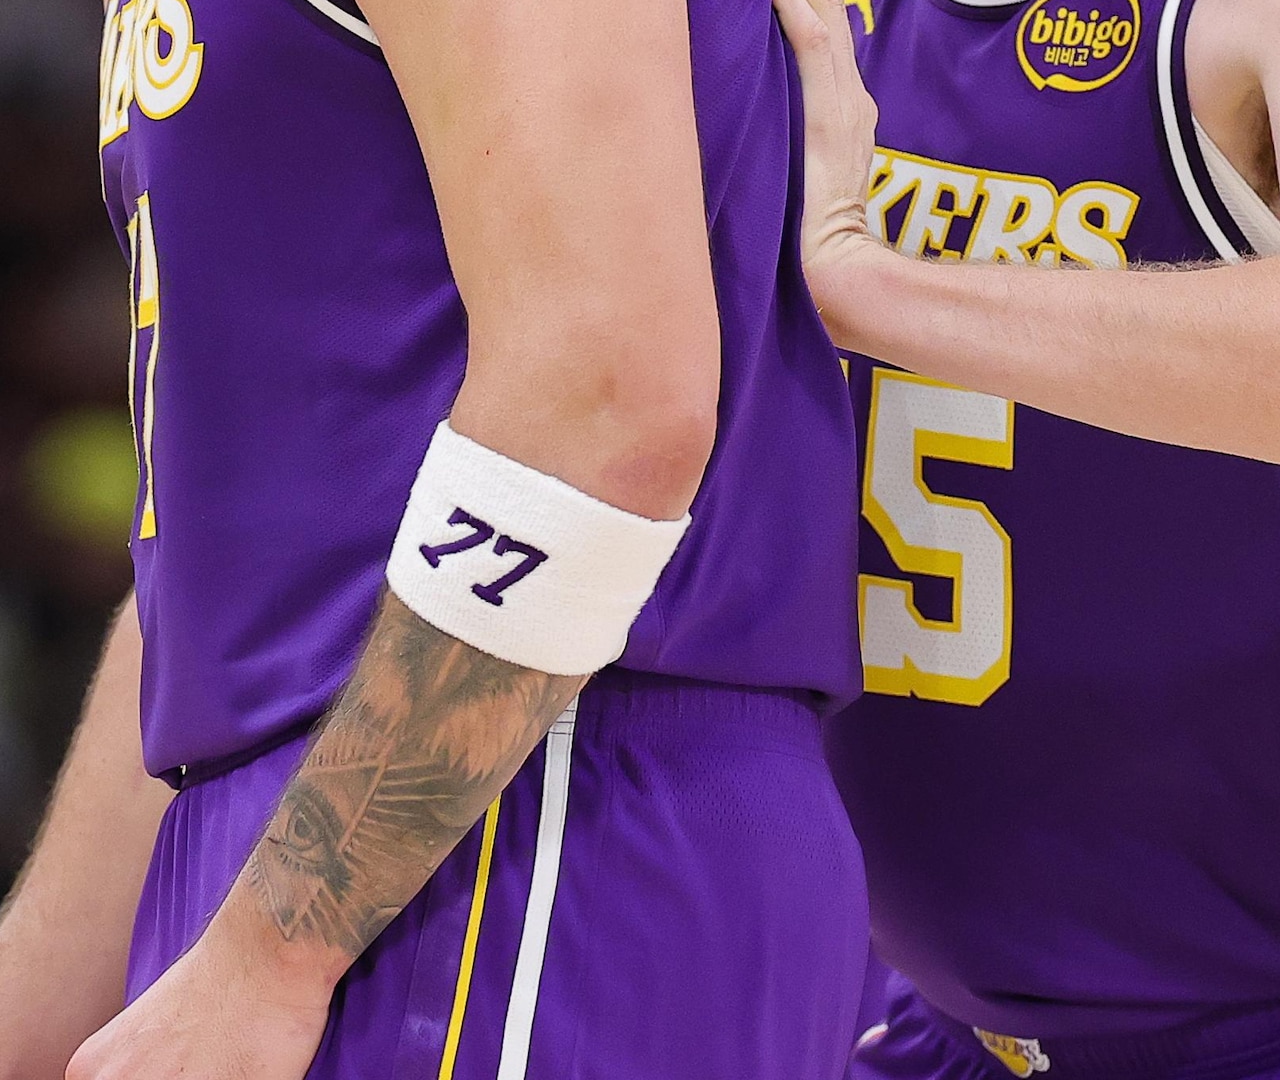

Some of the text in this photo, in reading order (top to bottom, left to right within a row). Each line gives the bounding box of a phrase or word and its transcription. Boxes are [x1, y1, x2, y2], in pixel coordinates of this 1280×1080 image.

[1029, 6, 1133, 60] bibigo
[1043, 46, 1090, 68] 비비고
[419, 506, 550, 607] 77
[839, 358, 1015, 707] 5
